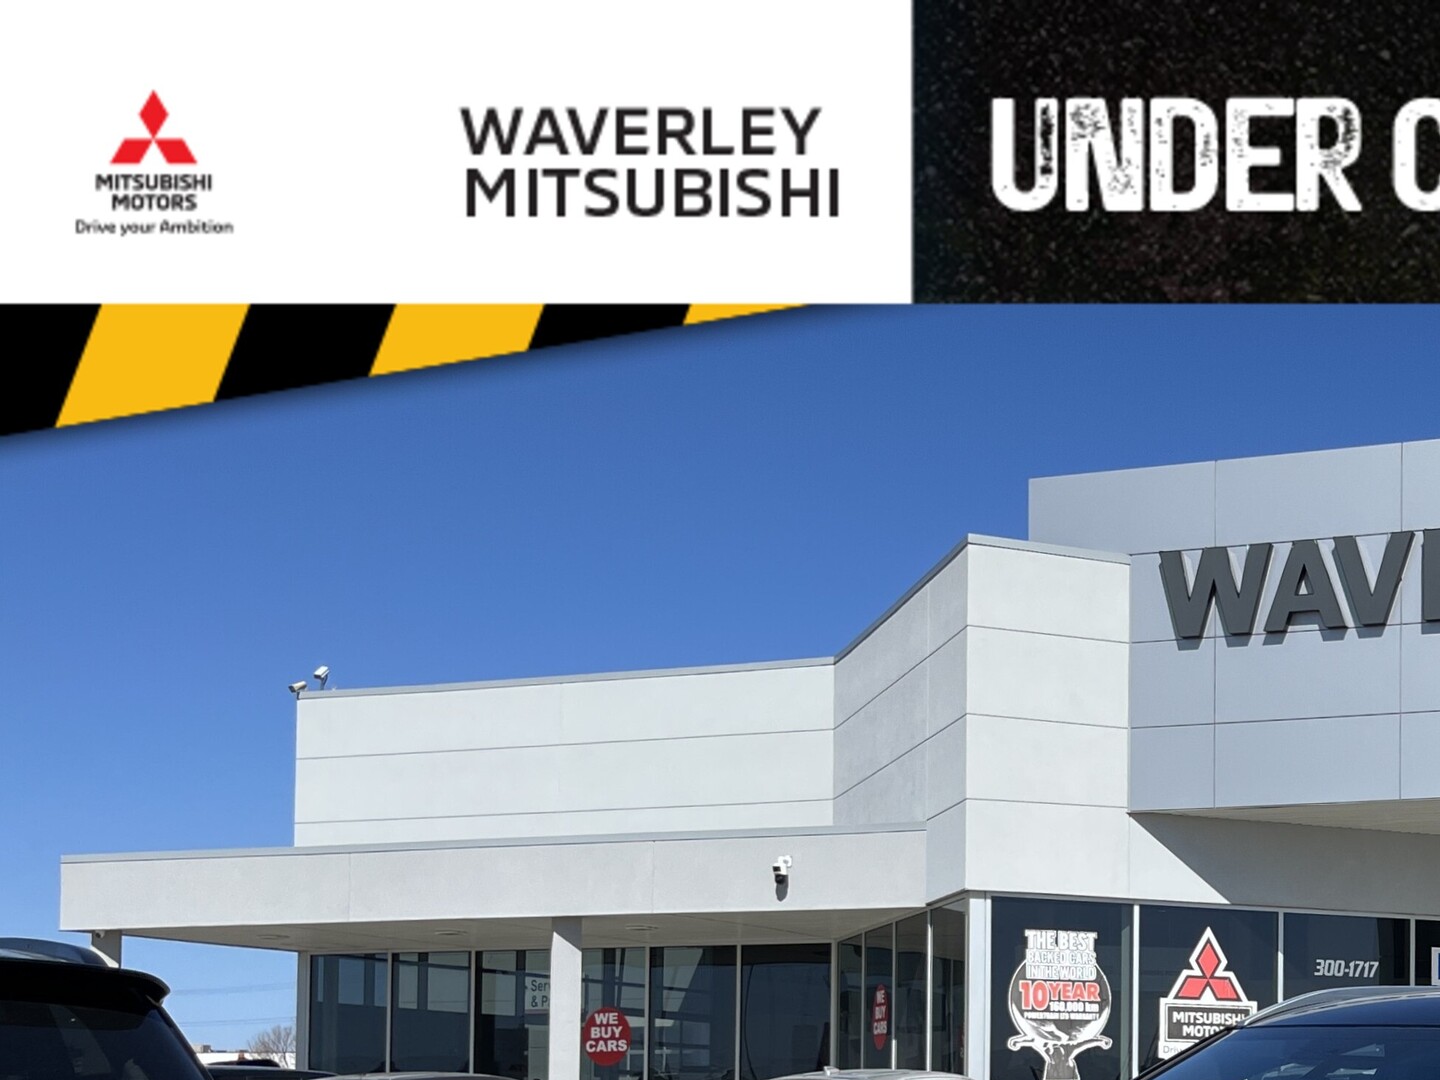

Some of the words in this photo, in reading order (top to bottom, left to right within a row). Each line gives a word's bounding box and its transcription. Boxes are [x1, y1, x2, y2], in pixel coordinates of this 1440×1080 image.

[1025, 929, 1057, 950] THE
[1058, 930, 1098, 951] BEST
[1027, 950, 1067, 965] BACKED
[1069, 952, 1097, 965] CARS
[1028, 965, 1039, 979] IN
[1040, 965, 1059, 979] THE
[1060, 965, 1097, 980] WORLD
[1314, 959, 1379, 977] 300-1717
[1019, 980, 1049, 1011] 10
[1048, 981, 1100, 1002] YEAR
[594, 1012, 619, 1025] WE
[591, 1026, 623, 1039] BUY
[1182, 1025, 1222, 1037] MOTO
[586, 1040, 628, 1053] CARS
